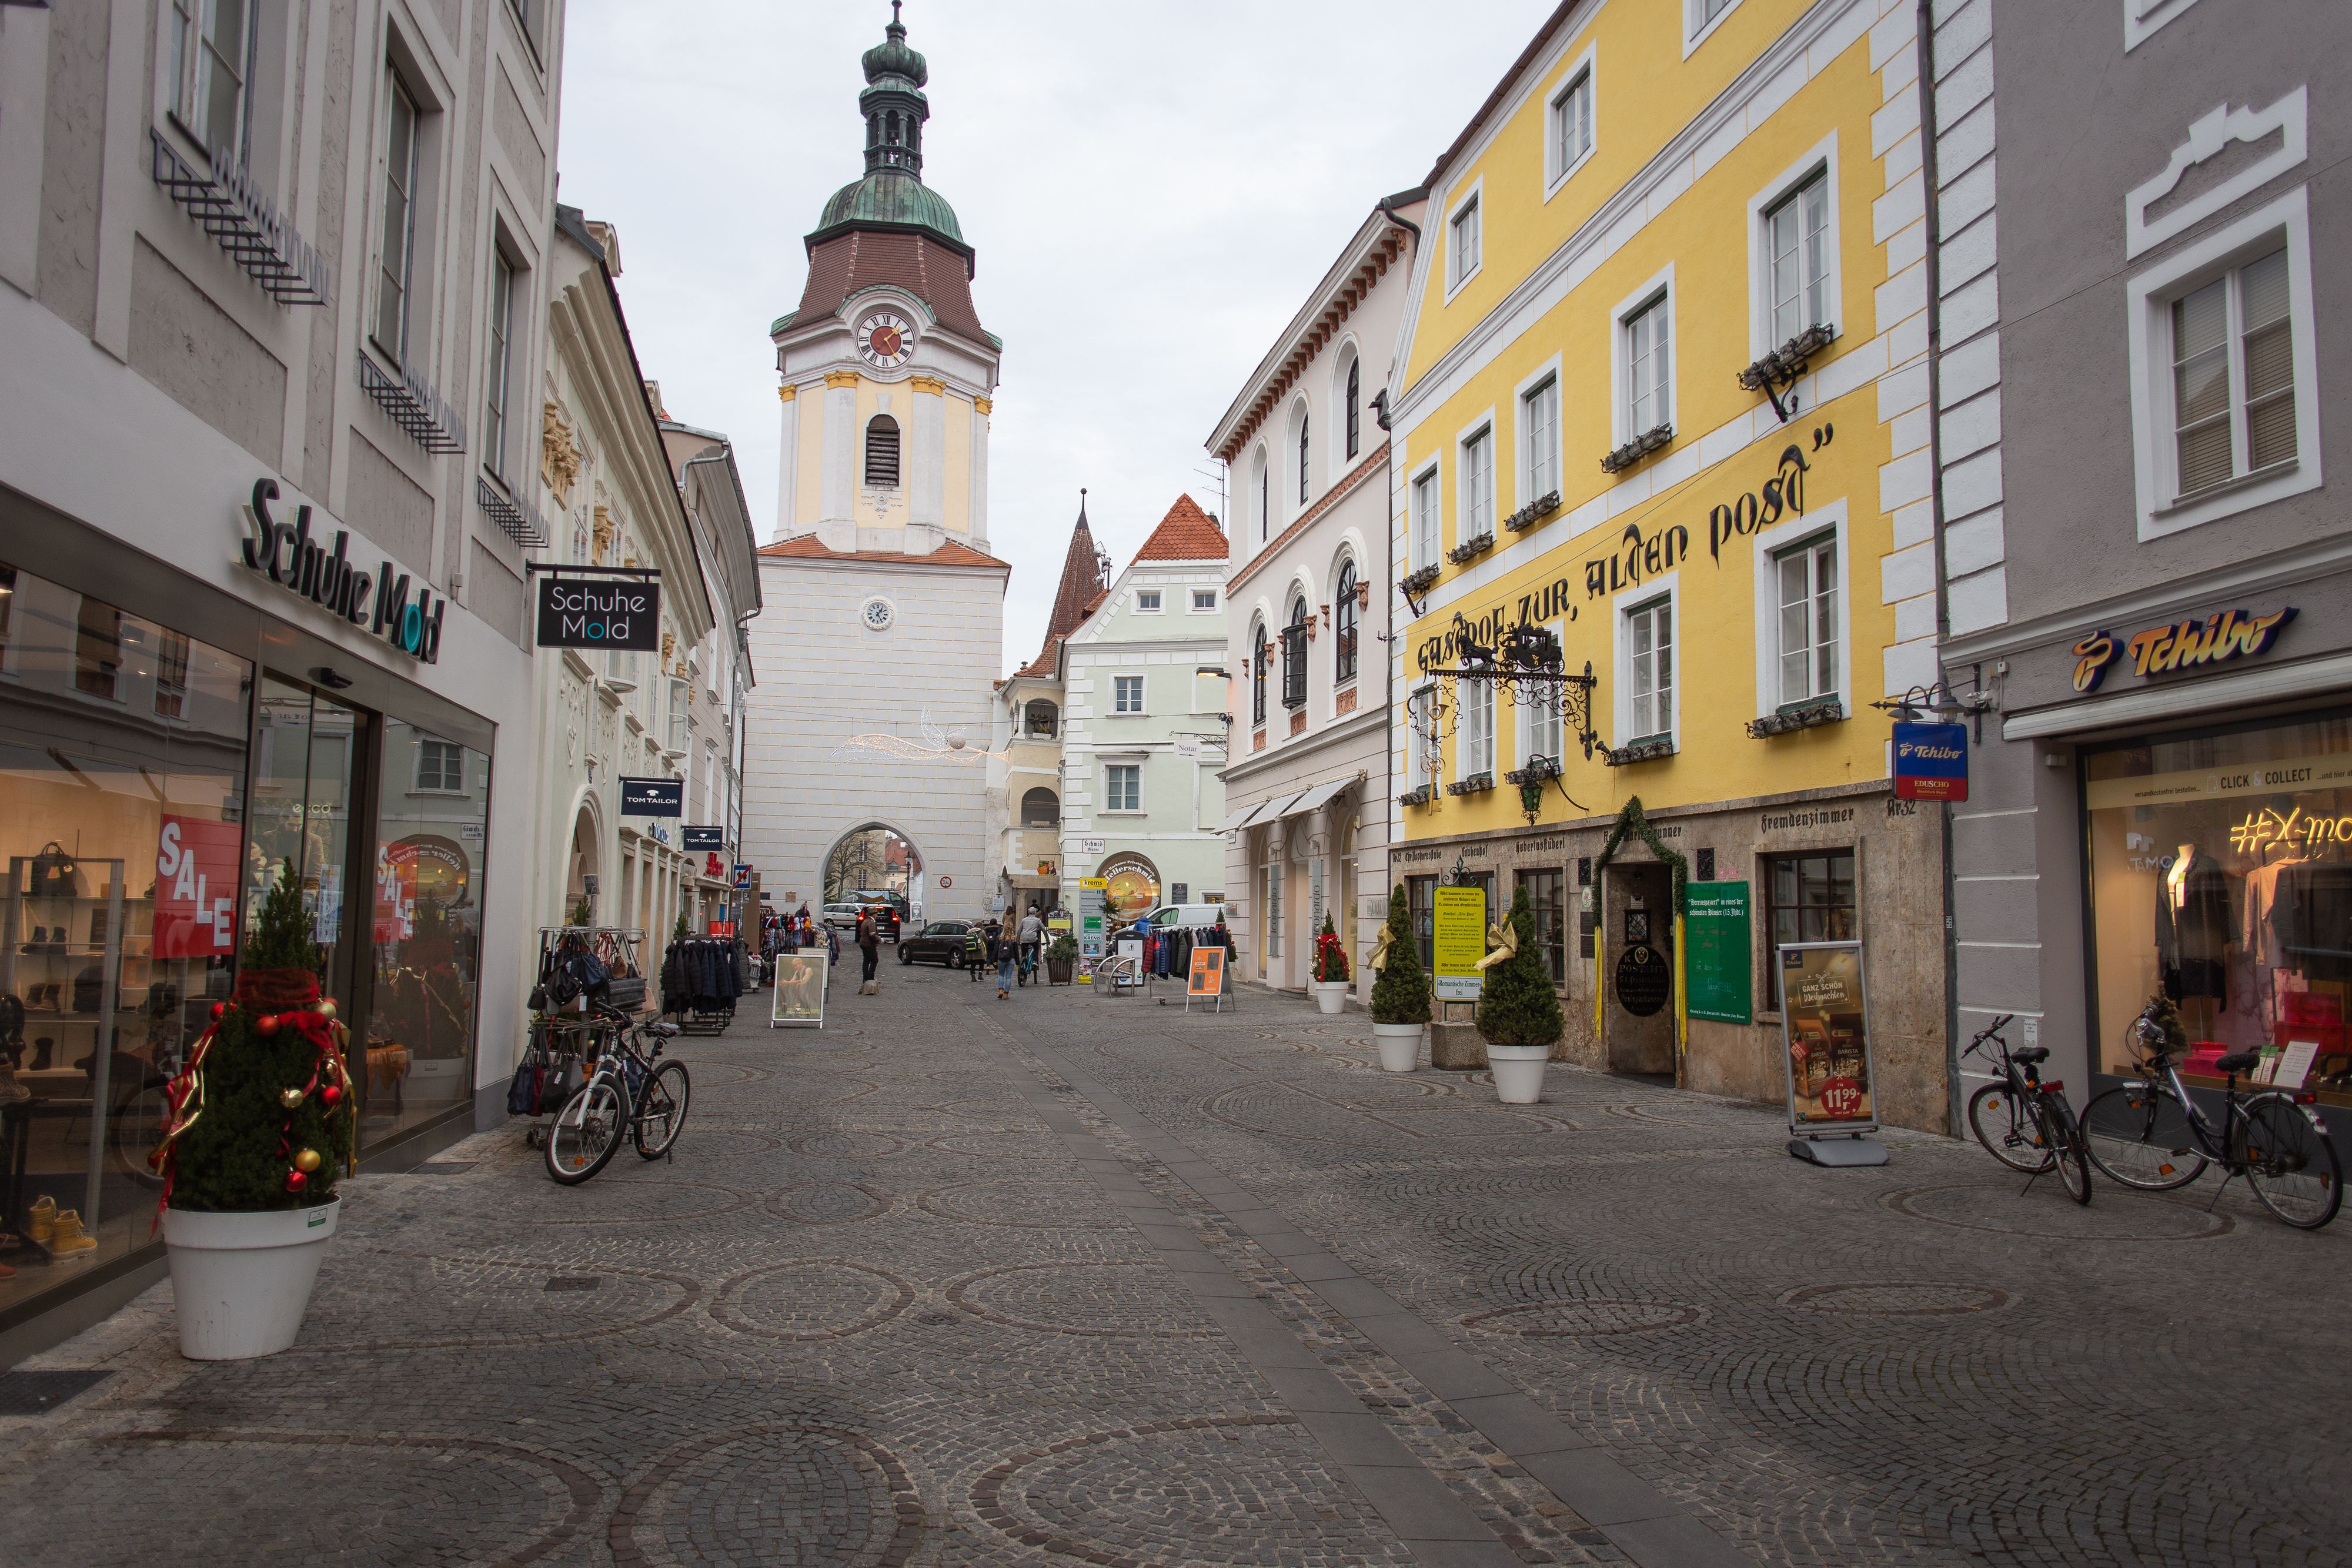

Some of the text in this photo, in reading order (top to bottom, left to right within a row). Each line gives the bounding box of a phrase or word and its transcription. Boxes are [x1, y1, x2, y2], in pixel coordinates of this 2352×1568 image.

[242, 477, 445, 665] Schuhe Mold
[1586, 523, 1689, 600] ALTEN
[550, 586, 646, 613] Schuhe
[563, 614, 629, 640] Mold
[2127, 606, 2300, 677] Tchibo
[1915, 745, 1963, 759] Tchibo
[2134, 787, 2174, 798] versandkostenfrei
[2220, 774, 2250, 790] CLICK
[2253, 771, 2263, 787] &
[2265, 767, 2311, 785] COLLECT
[2334, 770, 2345, 778] hier
[1761, 807, 1854, 834] Fremdenzimmer
[159, 821, 232, 947] SALE
[377, 846, 415, 934] SALE
[1802, 981, 1843, 992] GANZ SCHÖN
[1803, 990, 1845, 1002] Weihnachten
